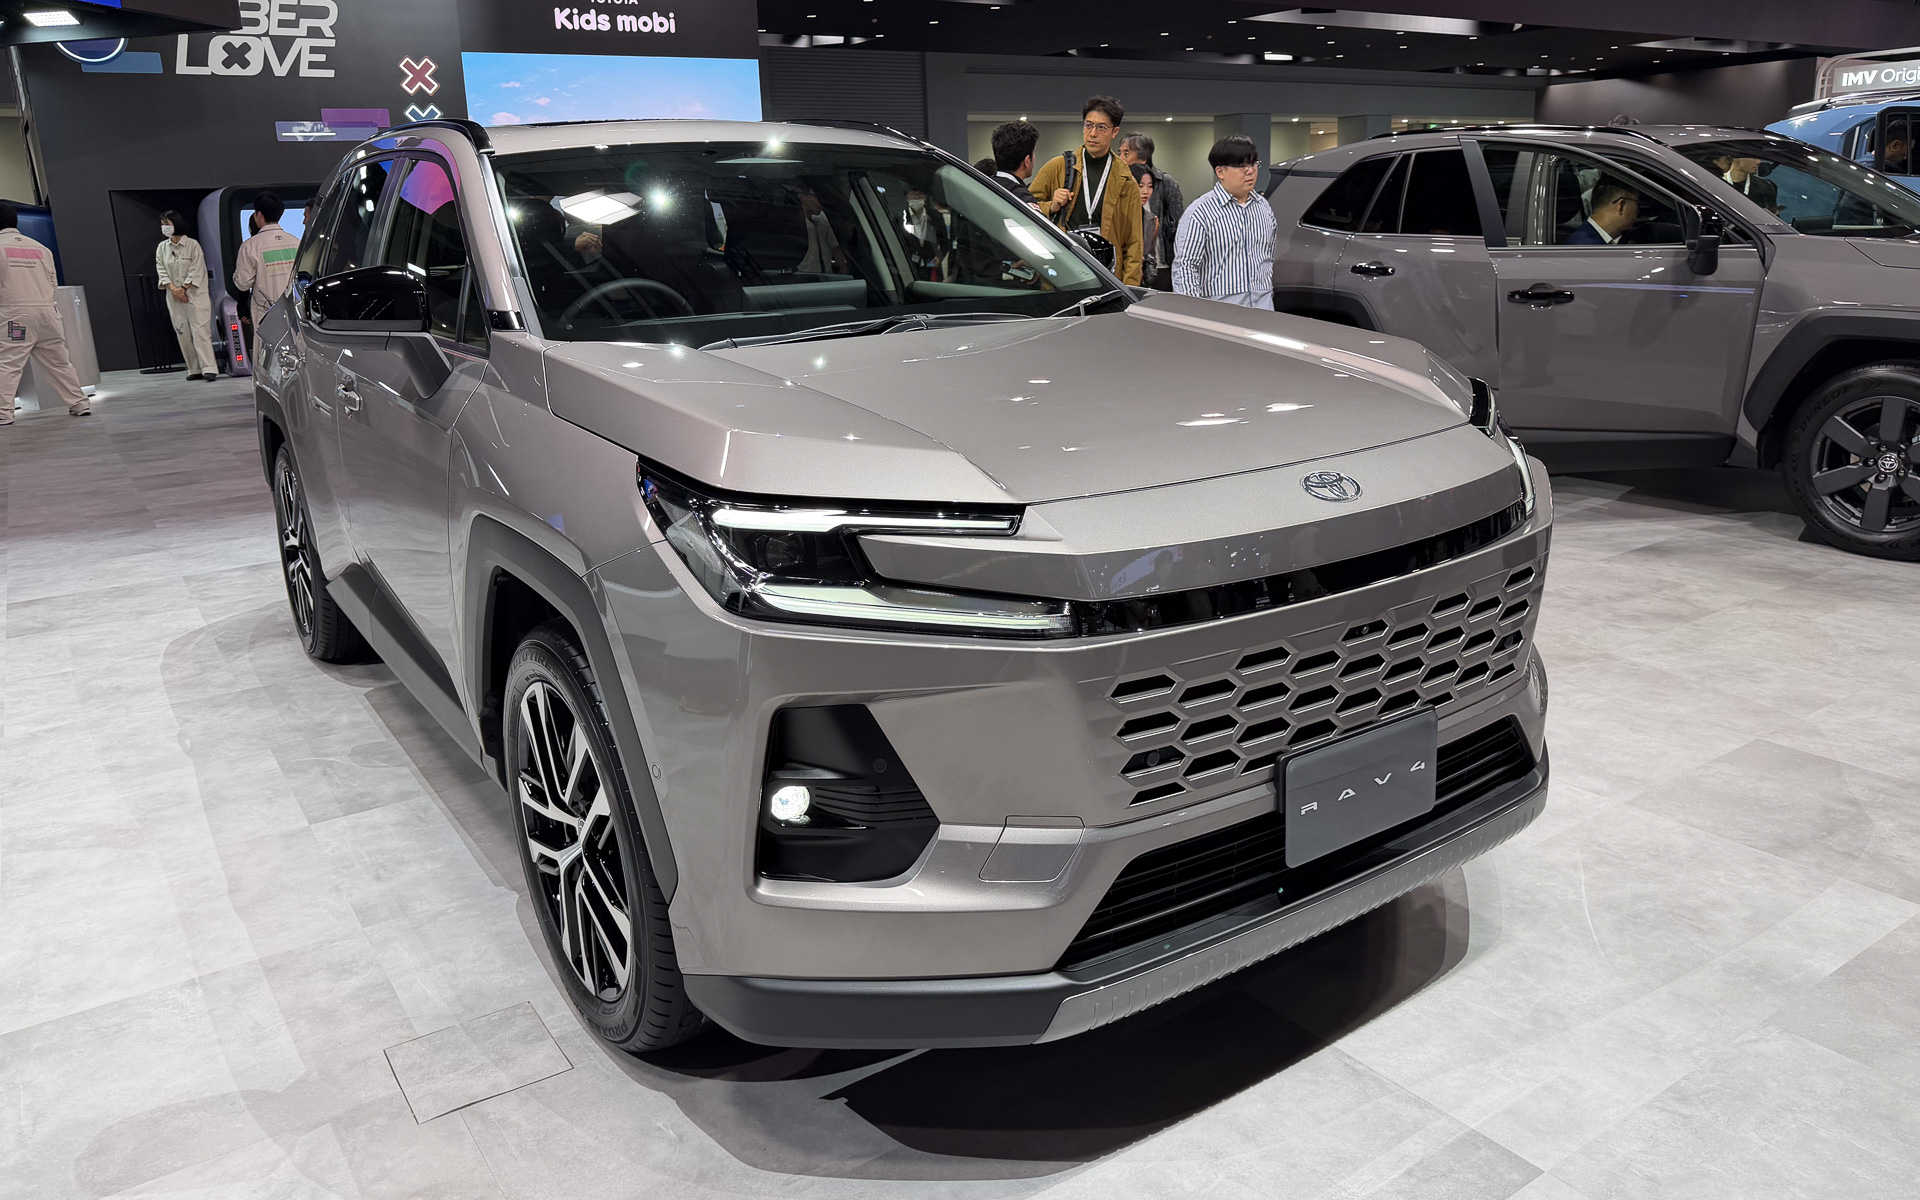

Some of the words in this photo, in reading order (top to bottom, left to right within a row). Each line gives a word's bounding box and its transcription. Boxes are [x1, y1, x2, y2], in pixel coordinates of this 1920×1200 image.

[228, 0, 339, 37] BER
[554, 7, 611, 31] Kids
[616, 11, 676, 34] mobi
[175, 33, 336, 78] LOVE
[1841, 69, 1878, 87] IMV
